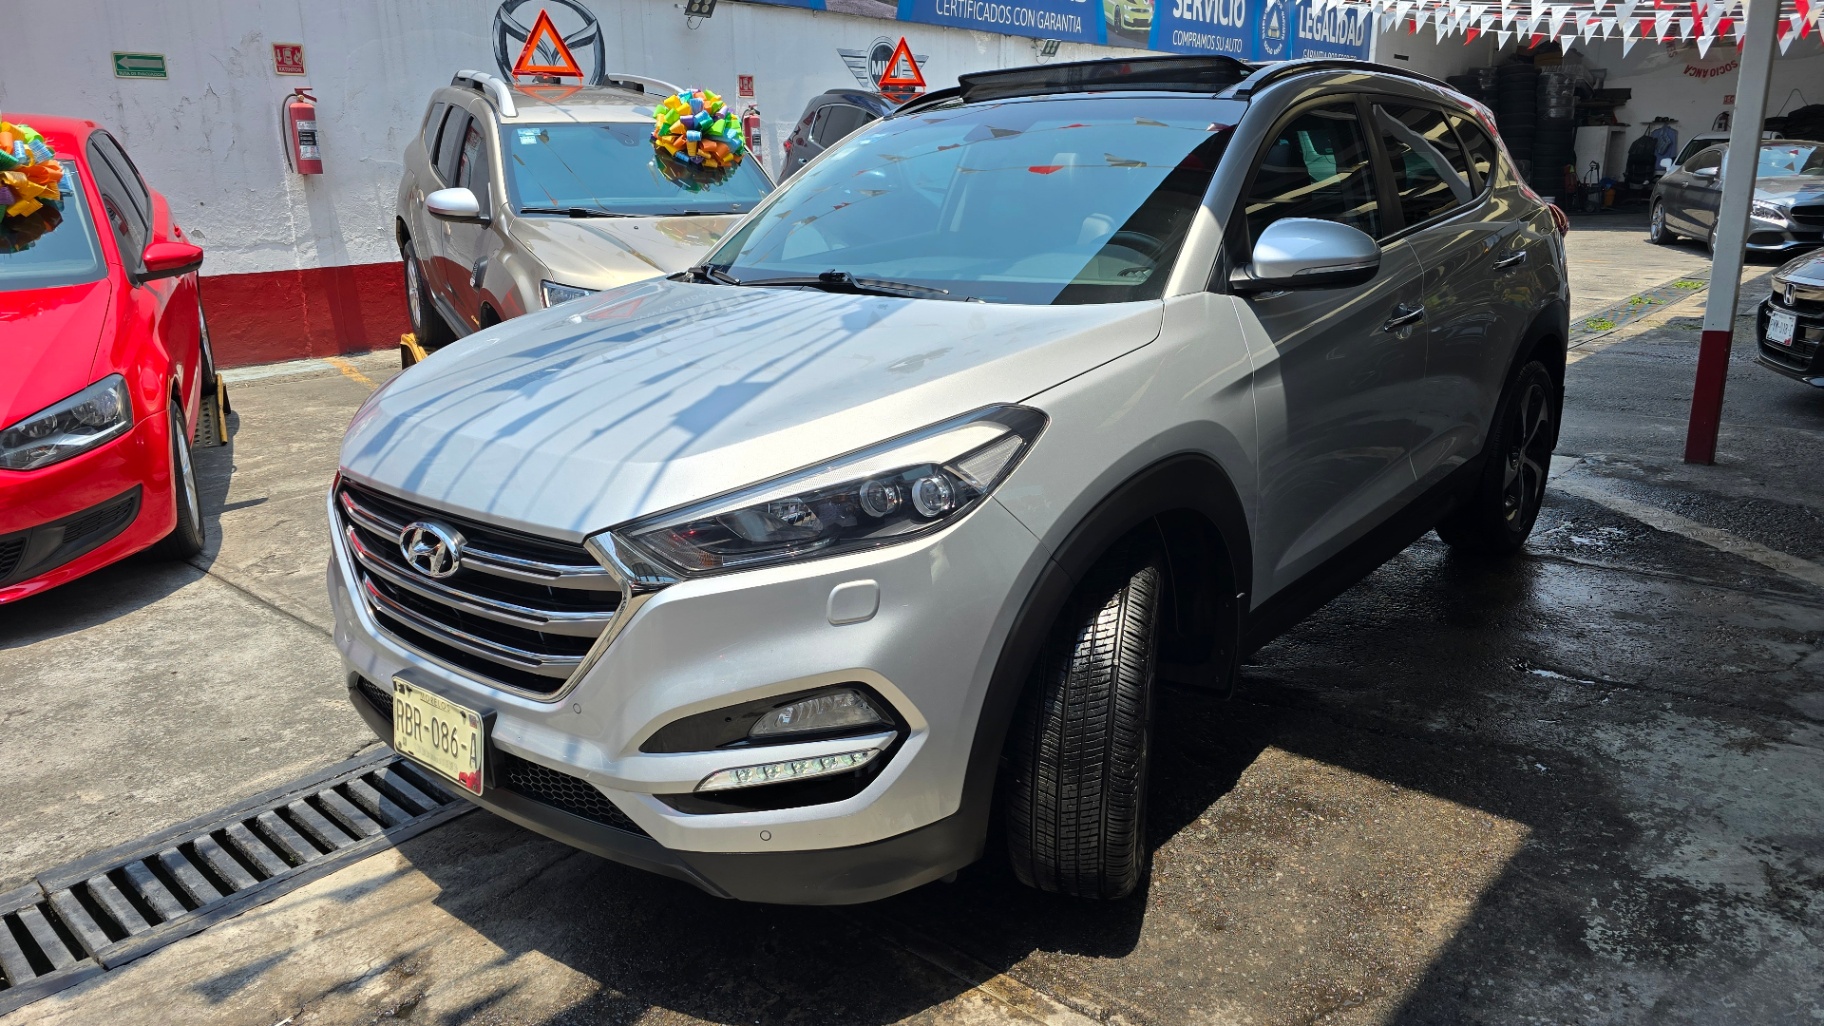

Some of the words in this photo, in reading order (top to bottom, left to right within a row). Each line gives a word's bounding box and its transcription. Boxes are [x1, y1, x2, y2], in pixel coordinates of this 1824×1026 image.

[935, 0, 1012, 25] CERTIFICADOS
[1013, 7, 1036, 28] CON
[1037, 10, 1082, 34] GARANTIA
[1172, 0, 1246, 29] SERVICIO
[1298, 5, 1365, 47] LEGALIDAD
[1172, 29, 1216, 50] COMPRAMOS
[1215, 35, 1225, 51] SU
[1224, 37, 1243, 53] AUTO
[1709, 59, 1739, 78] SOCIO
[419, 692, 451, 713] MORELOS
[396, 699, 478, 769] RBR-086-A
